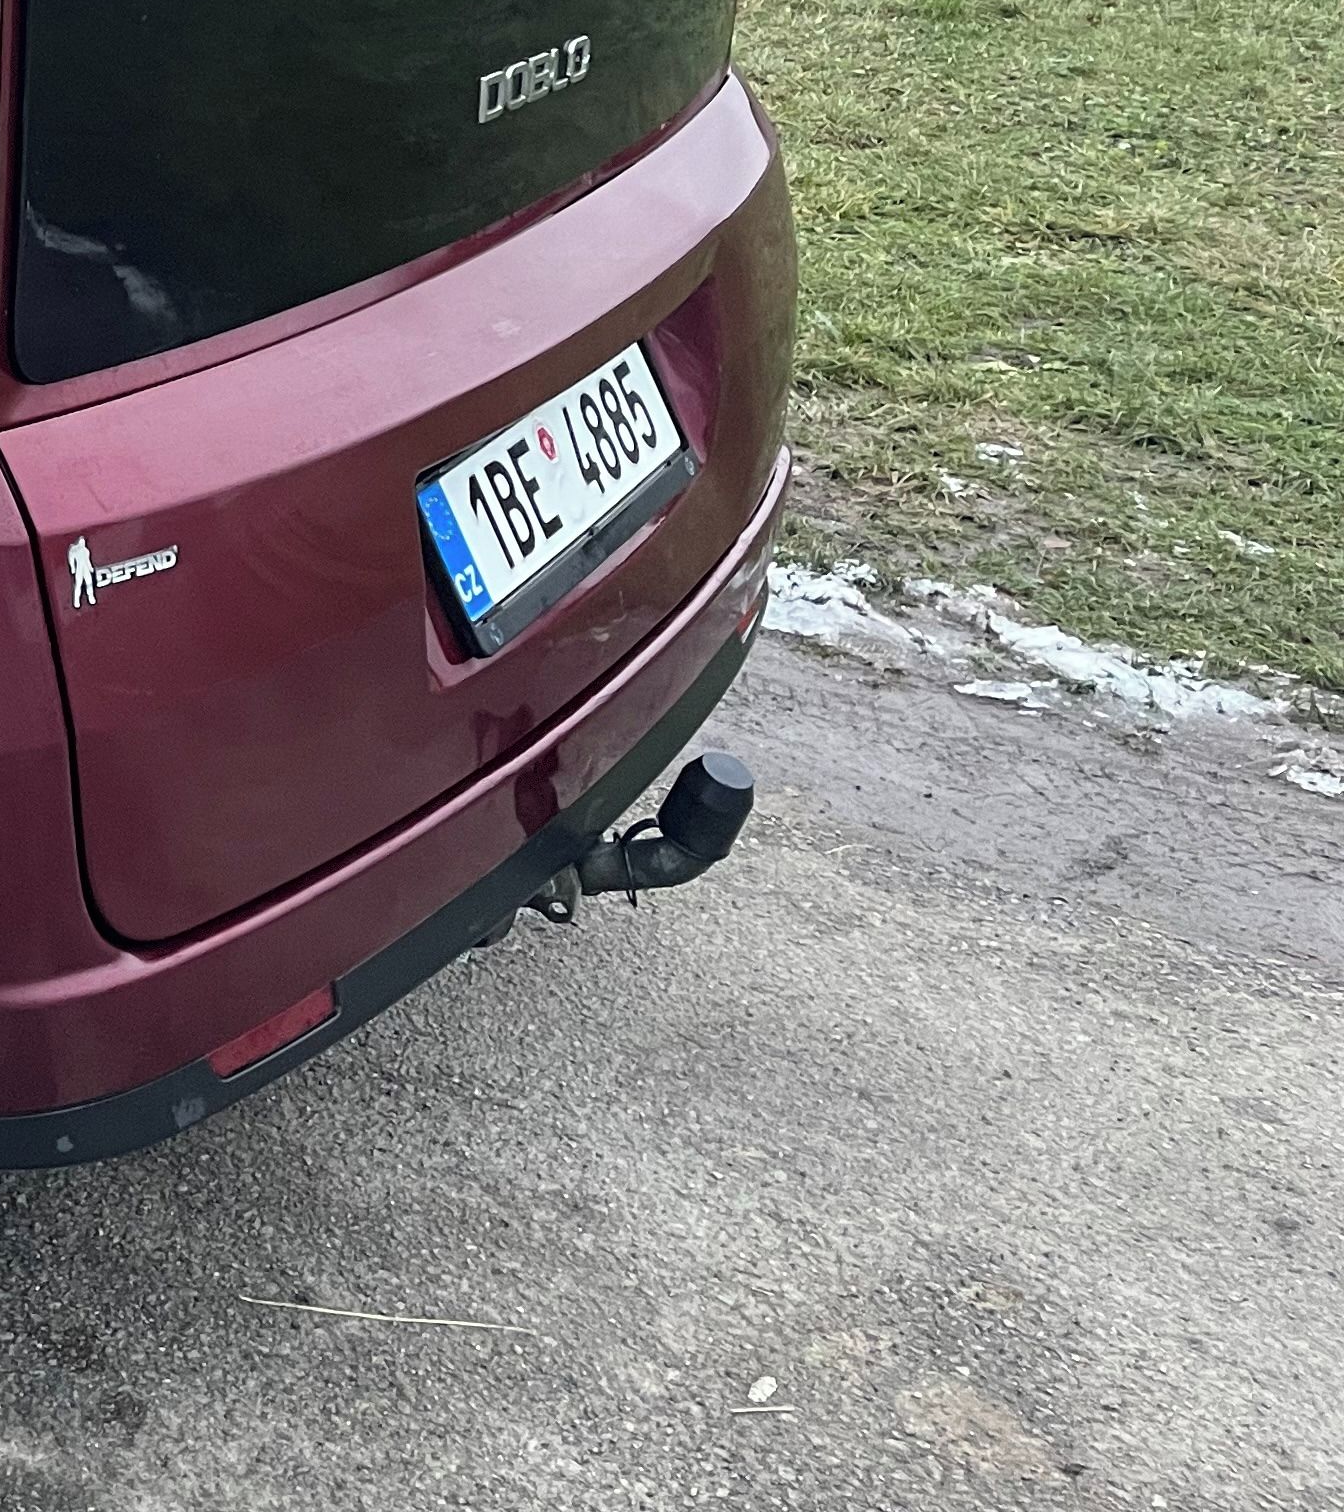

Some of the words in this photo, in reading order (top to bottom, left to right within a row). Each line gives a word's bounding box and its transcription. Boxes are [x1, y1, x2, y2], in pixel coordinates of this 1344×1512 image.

[478, 35, 591, 124] DOBLO
[468, 438, 564, 570] 1BE
[562, 360, 657, 495] 4885
[95, 549, 177, 587] DEFEND
[453, 564, 484, 604] CZ
